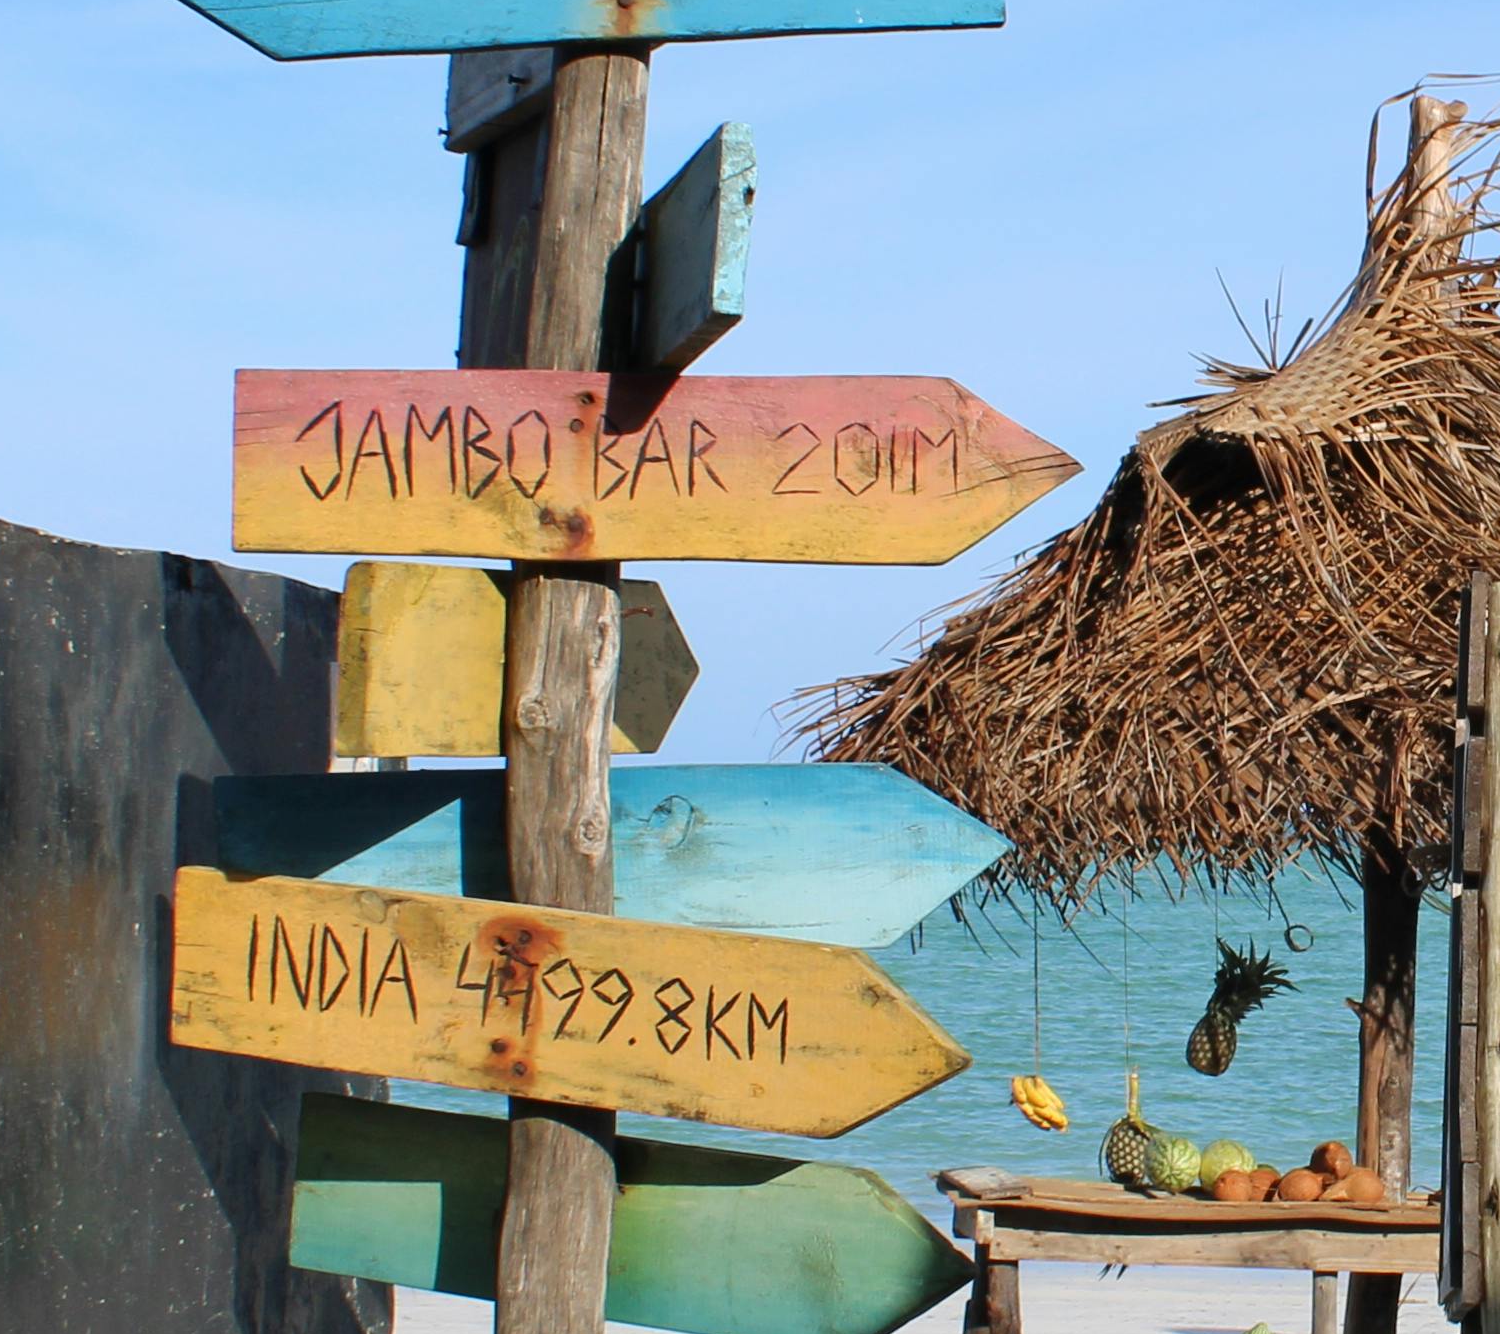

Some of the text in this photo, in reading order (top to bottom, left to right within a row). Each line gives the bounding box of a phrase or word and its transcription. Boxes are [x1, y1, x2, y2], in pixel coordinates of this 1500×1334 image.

[296, 399, 551, 501] JAMBO
[593, 411, 728, 501] BAR
[247, 913, 419, 1025] INDIA
